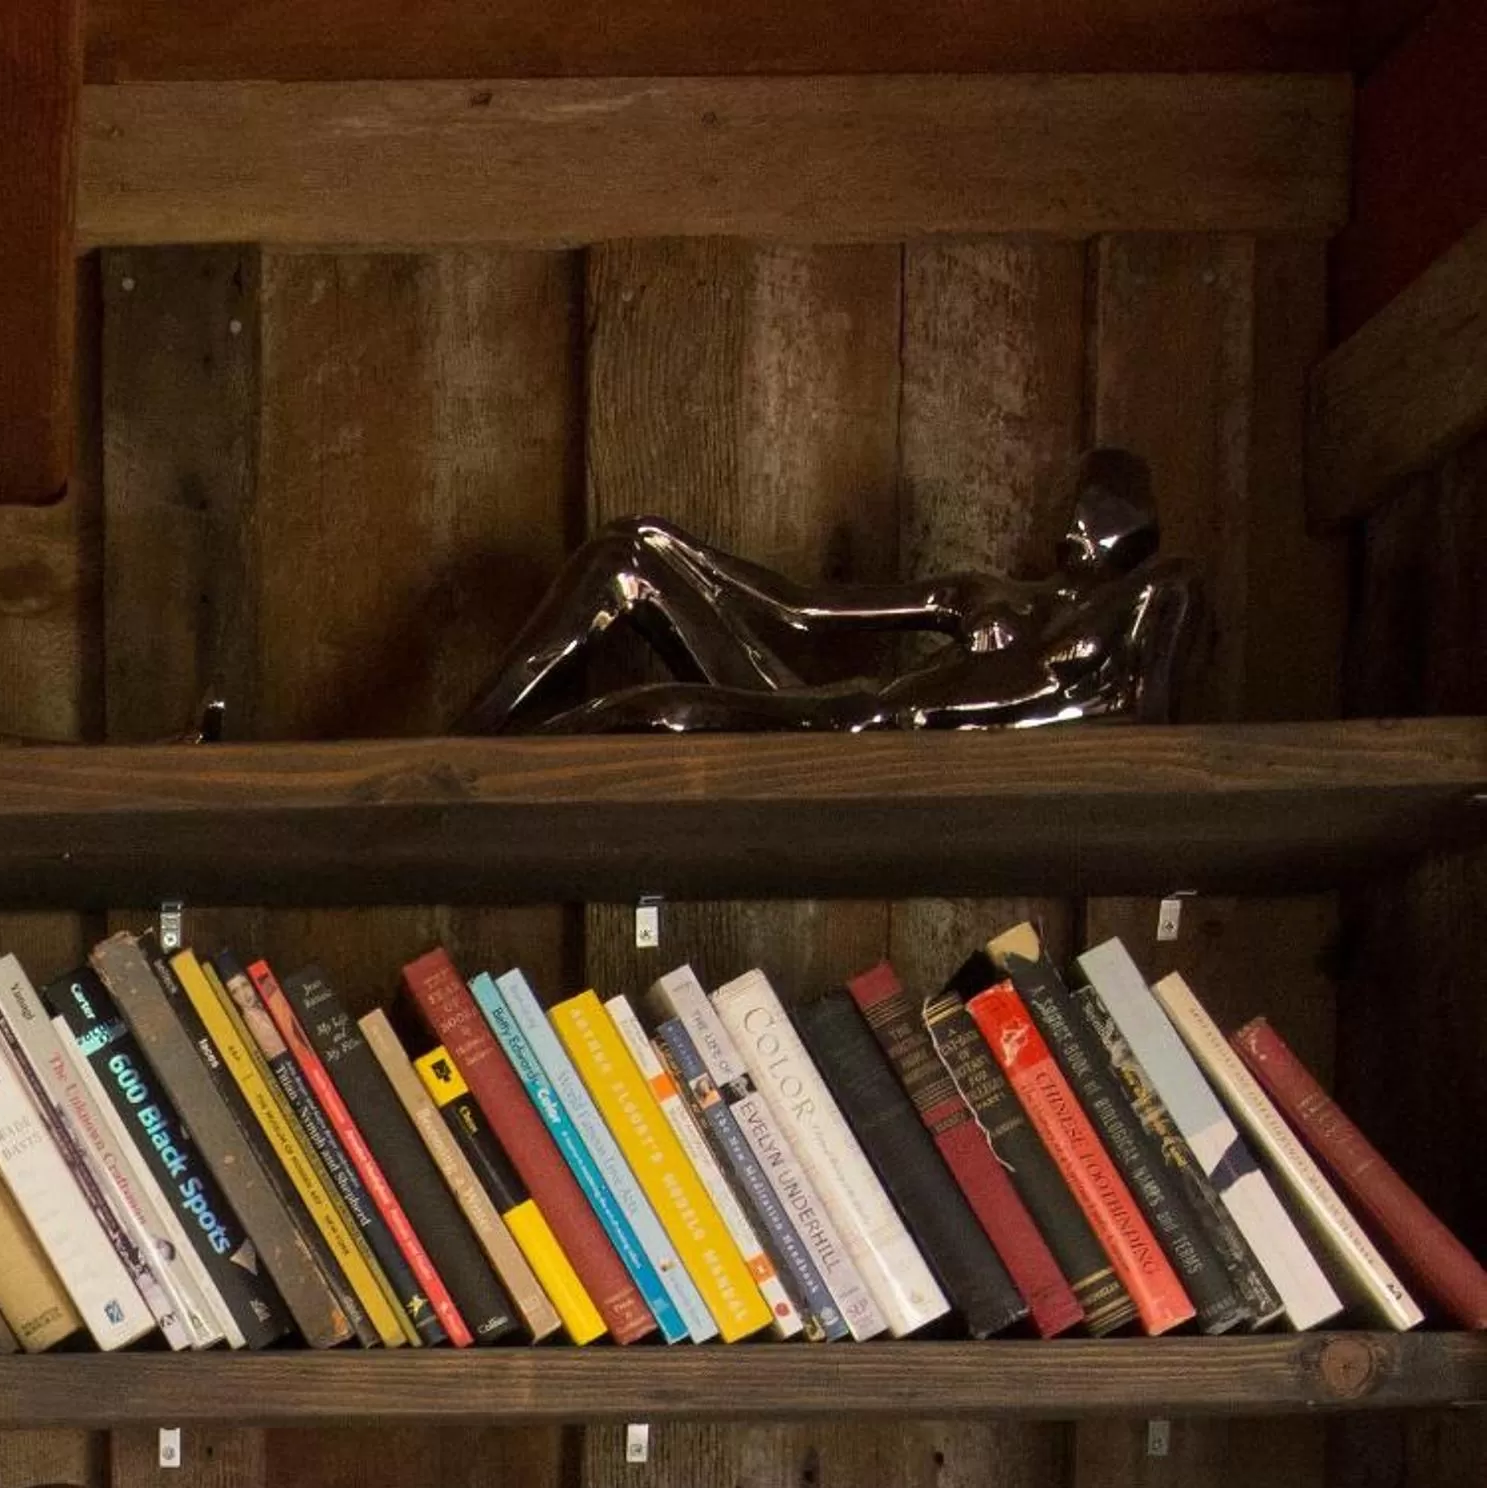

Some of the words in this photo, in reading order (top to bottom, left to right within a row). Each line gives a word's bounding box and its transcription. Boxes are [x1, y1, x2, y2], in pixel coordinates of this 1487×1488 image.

[65, 980, 100, 1022] Carter
[271, 1063, 301, 1101] Titian
[488, 1005, 516, 1039] Betty
[505, 1033, 544, 1087] Edwards
[743, 1006, 817, 1118] COLOR
[44, 1049, 72, 1082] The
[61, 1082, 110, 1153] Unknown
[293, 1104, 329, 1152] Nymph
[533, 1084, 566, 1127] Color
[108, 1052, 148, 1105] 600
[137, 1104, 189, 1178] Black
[177, 1174, 233, 1256] Spots
[319, 1146, 342, 1173] and
[739, 1101, 786, 1169] EVELYN
[777, 1168, 842, 1274] UNDERHILL
[1034, 1071, 1089, 1152] CHINESE
[1079, 1150, 1162, 1276] FOOTBINDING
[1095, 1097, 1140, 1164] BIOLOGICAL
[1171, 1236, 1205, 1277] TERMS
[330, 1168, 373, 1229] Shepherd
[710, 1109, 733, 1135] The
[725, 1134, 748, 1162] New
[739, 1162, 788, 1233] Meditation
[778, 1233, 823, 1296] Handbook
[476, 1314, 510, 1335] Collins
